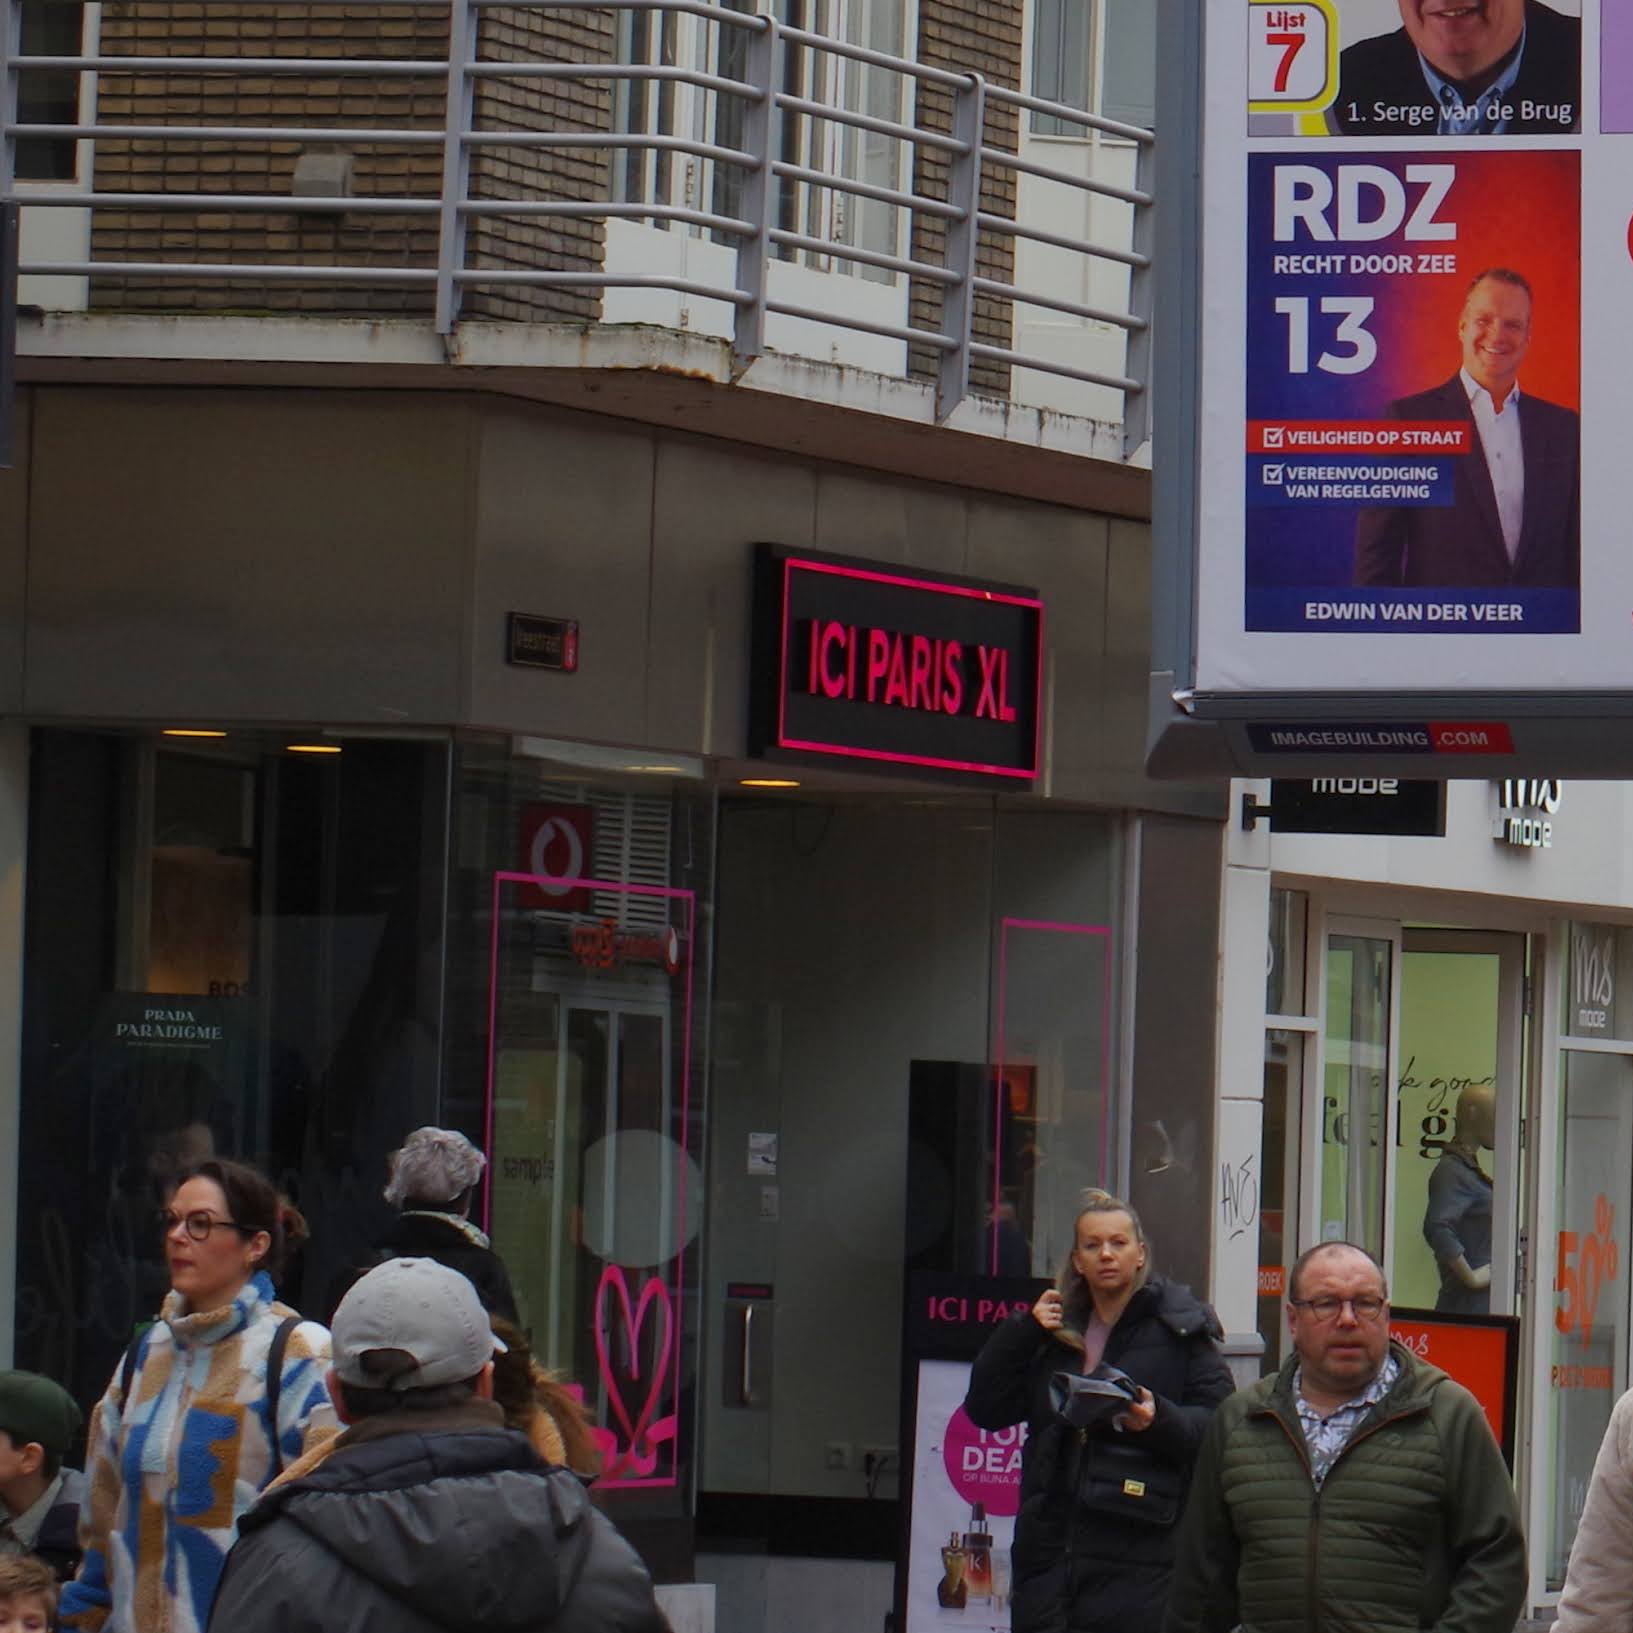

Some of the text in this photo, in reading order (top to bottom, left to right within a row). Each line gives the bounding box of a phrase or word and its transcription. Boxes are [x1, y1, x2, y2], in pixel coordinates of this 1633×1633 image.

[1266, 11, 1306, 30] Lijst
[1266, 34, 1306, 92] 7
[1348, 99, 1572, 128] 1. Serge van de Brug
[1273, 164, 1457, 243] RDZ
[1273, 253, 1456, 274] RECHT DOOR ZEE
[1275, 295, 1377, 375] 13
[1287, 426, 1463, 448] VEILIGHEID OP STRAAT
[1286, 464, 1439, 484] VEREENVOUDIGING
[1286, 482, 1430, 501] VAN REGELGEVING
[1304, 603, 1525, 622] EDWIN VAN DER VEER
[808, 619, 1016, 724] ICI PARIS XL
[144, 1009, 195, 1022] PRADA
[116, 1022, 223, 1040] PARADIGME
[928, 1296, 968, 1321] ICI
